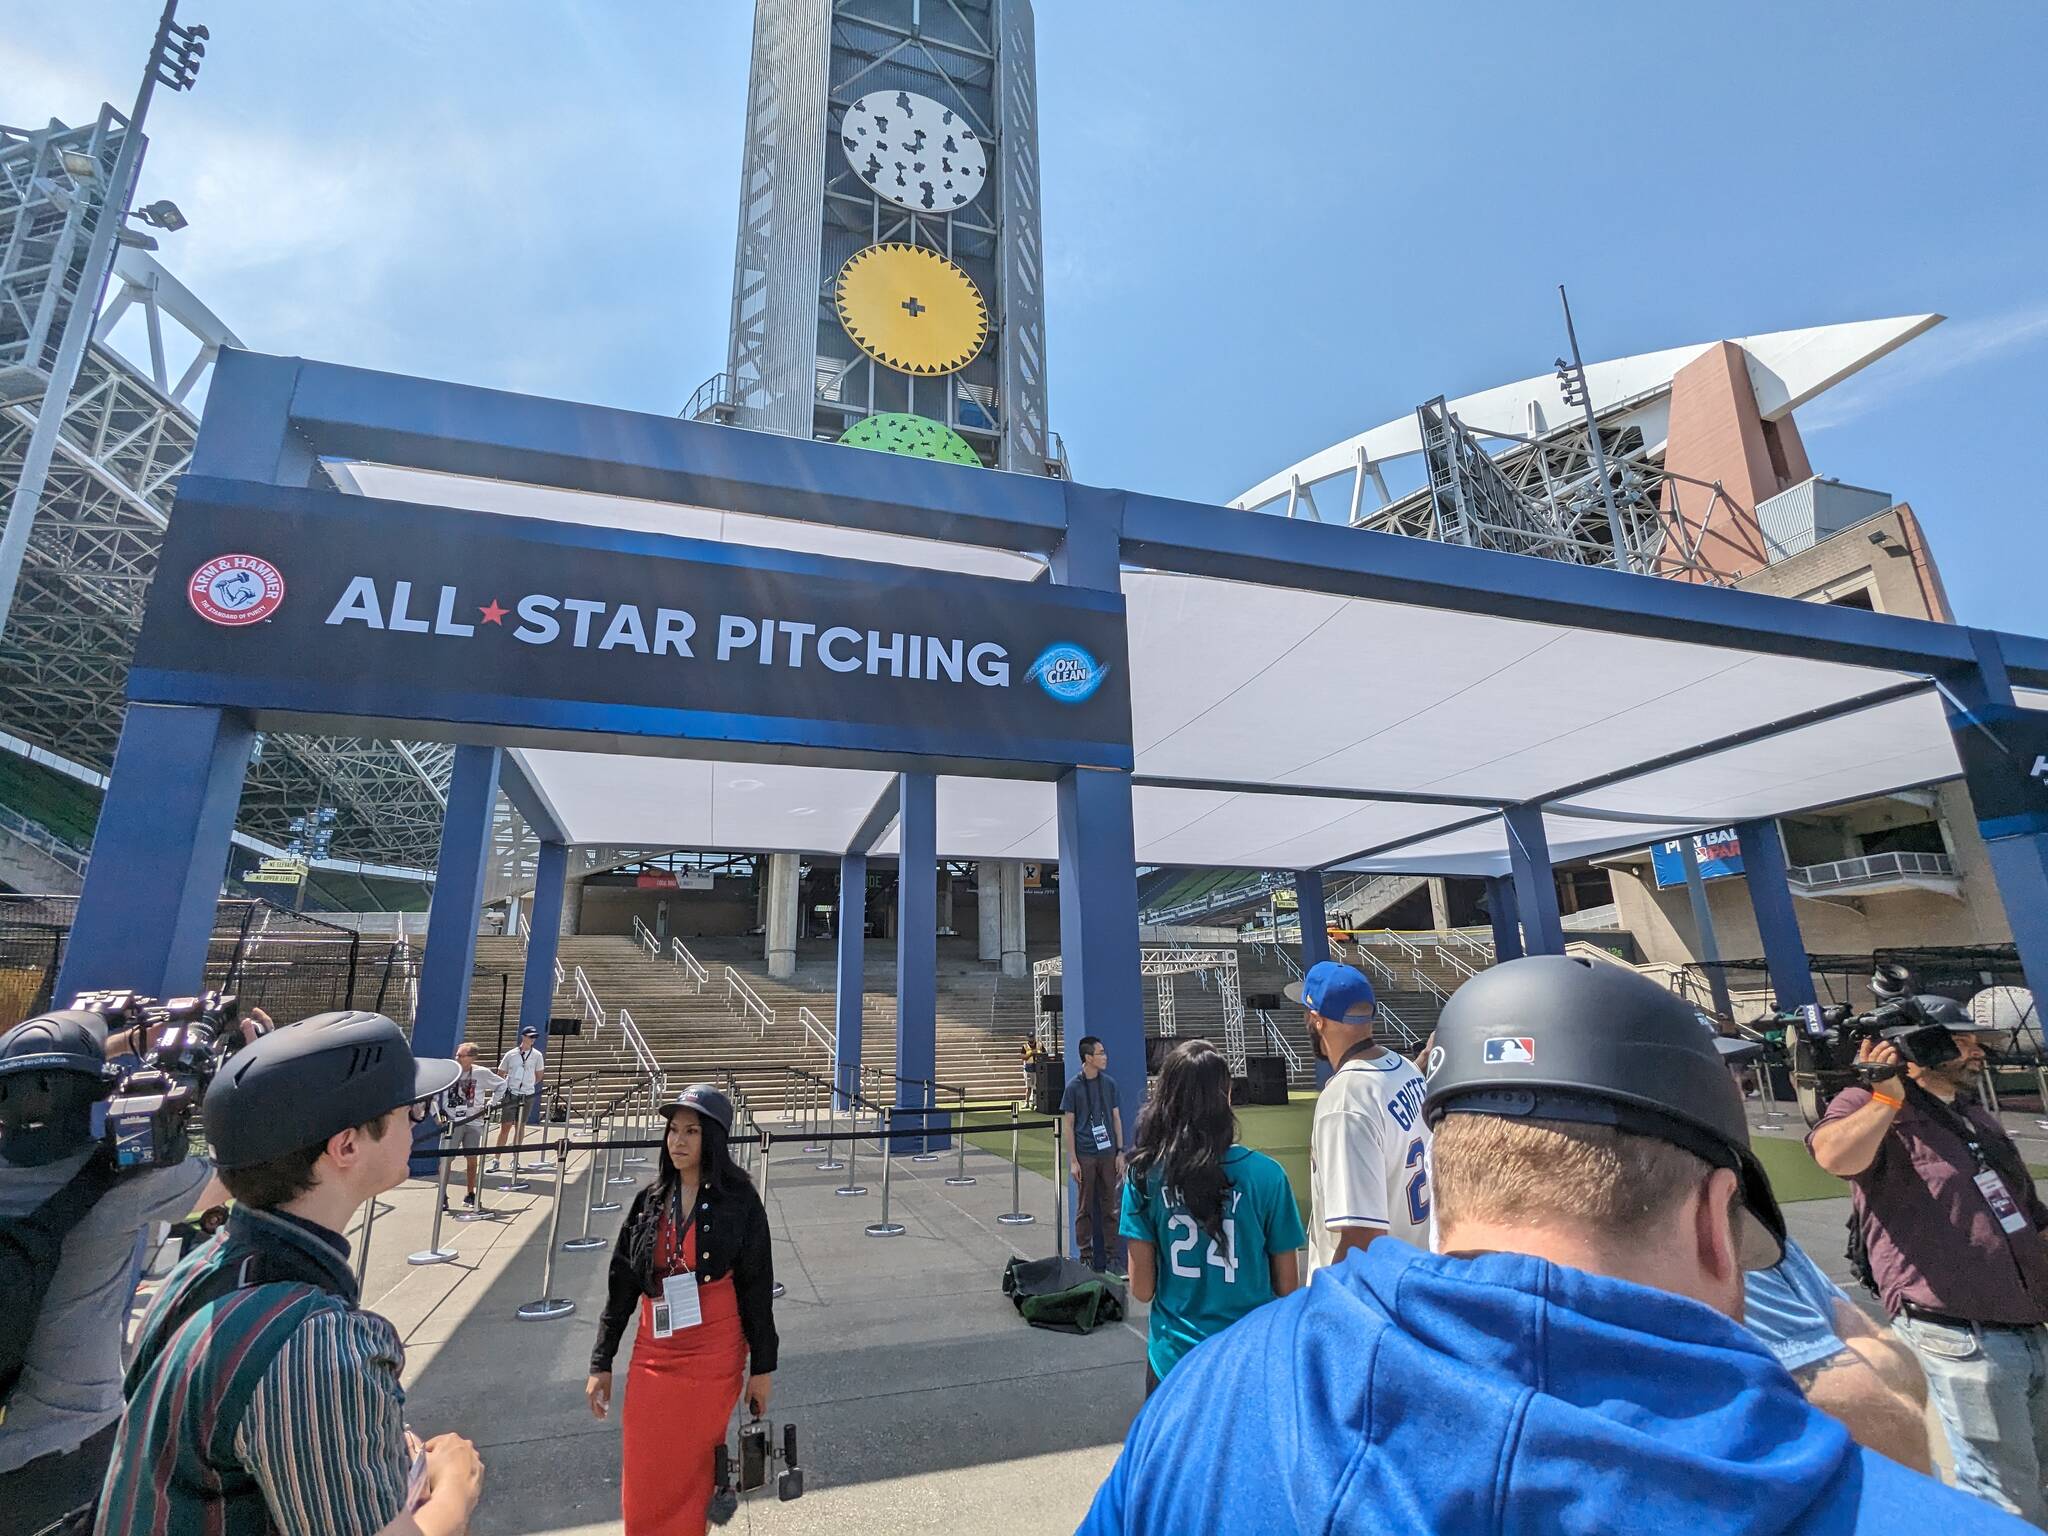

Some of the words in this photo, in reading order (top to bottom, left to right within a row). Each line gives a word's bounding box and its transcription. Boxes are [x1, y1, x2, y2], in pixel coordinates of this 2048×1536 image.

[194, 565, 219, 593] ARM
[219, 560, 231, 570] &
[234, 558, 280, 599] HAMMER
[208, 608, 237, 620] STANDARD
[247, 605, 266, 618] PURITY
[325, 575, 475, 637] ALL
[513, 593, 696, 658] STAR
[716, 613, 1010, 687] PITCHING
[1054, 659, 1079, 673] OXI
[1046, 668, 1087, 685] CLEAN
[1806, 1005, 1817, 1022] FOX
[1810, 1022, 1820, 1033] 13
[1167, 1214, 1239, 1283] 24
